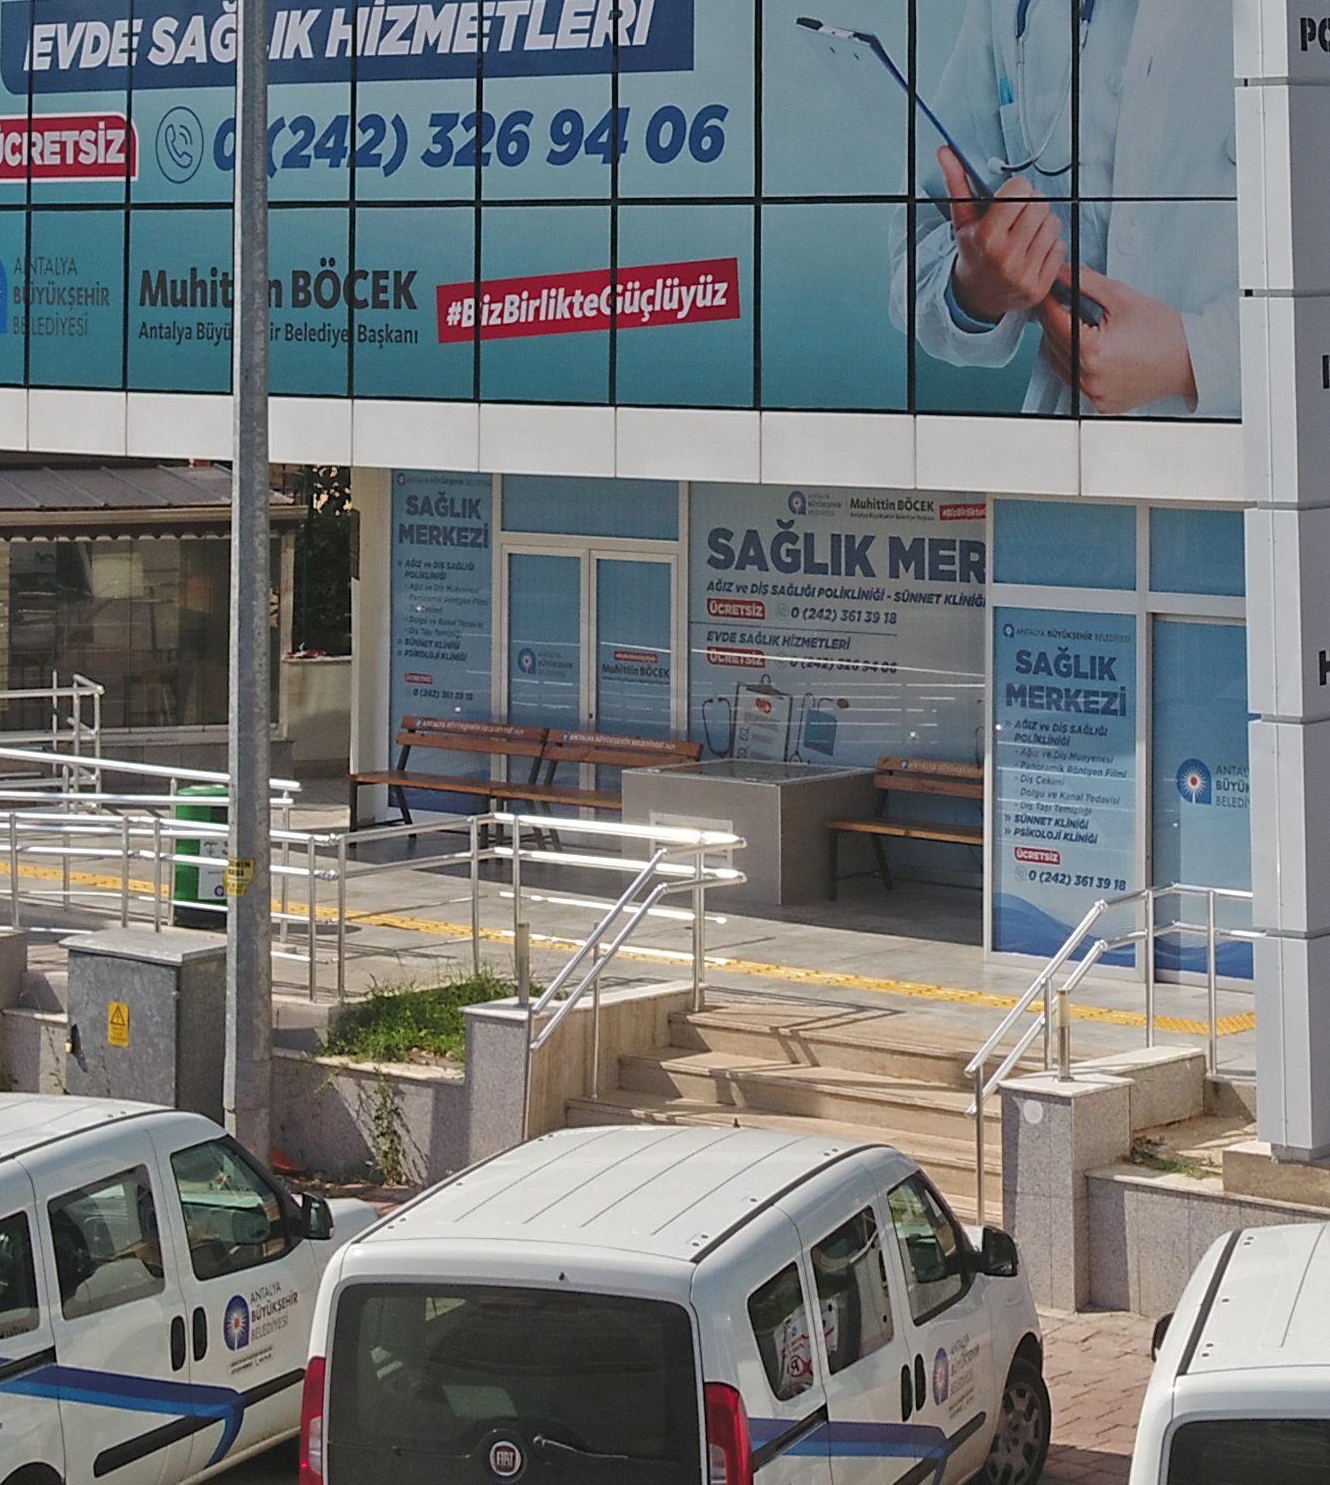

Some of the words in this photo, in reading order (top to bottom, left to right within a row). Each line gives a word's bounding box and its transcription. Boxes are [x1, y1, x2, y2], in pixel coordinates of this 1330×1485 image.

[23, 18, 142, 71] EVDE
[147, 0, 322, 66] SAĞIK
[268, 113, 409, 179] (242)
[420, 109, 533, 169] 326
[546, 105, 629, 167] 94
[644, 104, 730, 164] 06
[139, 266, 282, 309] Muhitn
[291, 257, 418, 310] BÖCEK
[446, 274, 728, 328] #BizBirlikteGüçlüyüz
[138, 321, 192, 346] Antalya
[284, 323, 352, 347] Belediye
[357, 324, 418, 349] Başkanı
[406, 491, 482, 520] SAĞLIK
[849, 497, 895, 511] Muhittin
[897, 497, 935, 513] BÖCEK
[398, 523, 489, 549] MERKEZİ
[706, 518, 877, 579] SAĞLIK
[706, 579, 734, 593] AĞIZ
[735, 584, 749, 594] ve
[750, 580, 769, 596] DİŞ
[771, 582, 816, 599] SAĞLIĞI
[817, 585, 885, 603] POLİKLİNİĞİ
[894, 588, 942, 605] SÜNNET
[709, 601, 764, 617] ÜCRETSİZ
[790, 606, 799, 619] 0
[802, 607, 837, 623] (242)
[840, 608, 861, 623] 361
[884, 611, 898, 625] 18
[706, 630, 737, 643] EVDE
[739, 630, 780, 646] SAĞLIK
[782, 633, 851, 650] HİZMETLERİ
[1015, 646, 1117, 681] SAĞLIK
[1005, 682, 1127, 717] MERKEZİ
[1014, 718, 1038, 730] AĞIZ
[1039, 722, 1050, 732] ve
[1052, 721, 1068, 734] DİŞ
[1069, 722, 1108, 737] SAĞLIĞI
[1013, 813, 1053, 825] SÜNNET
[1054, 816, 1090, 831] KLİNİĞİ
[1013, 827, 1062, 841] PSİKOLOJİ
[1062, 831, 1099, 845] KLİNİĞİ
[1016, 848, 1059, 862] ÜCRETSİZ
[1028, 869, 1037, 881] 0
[1039, 871, 1071, 886] (242)
[1073, 874, 1094, 888] 361
[1095, 877, 1111, 889] 39
[1113, 879, 1127, 891] 18
[251, 1281, 282, 1304] ANTALYA
